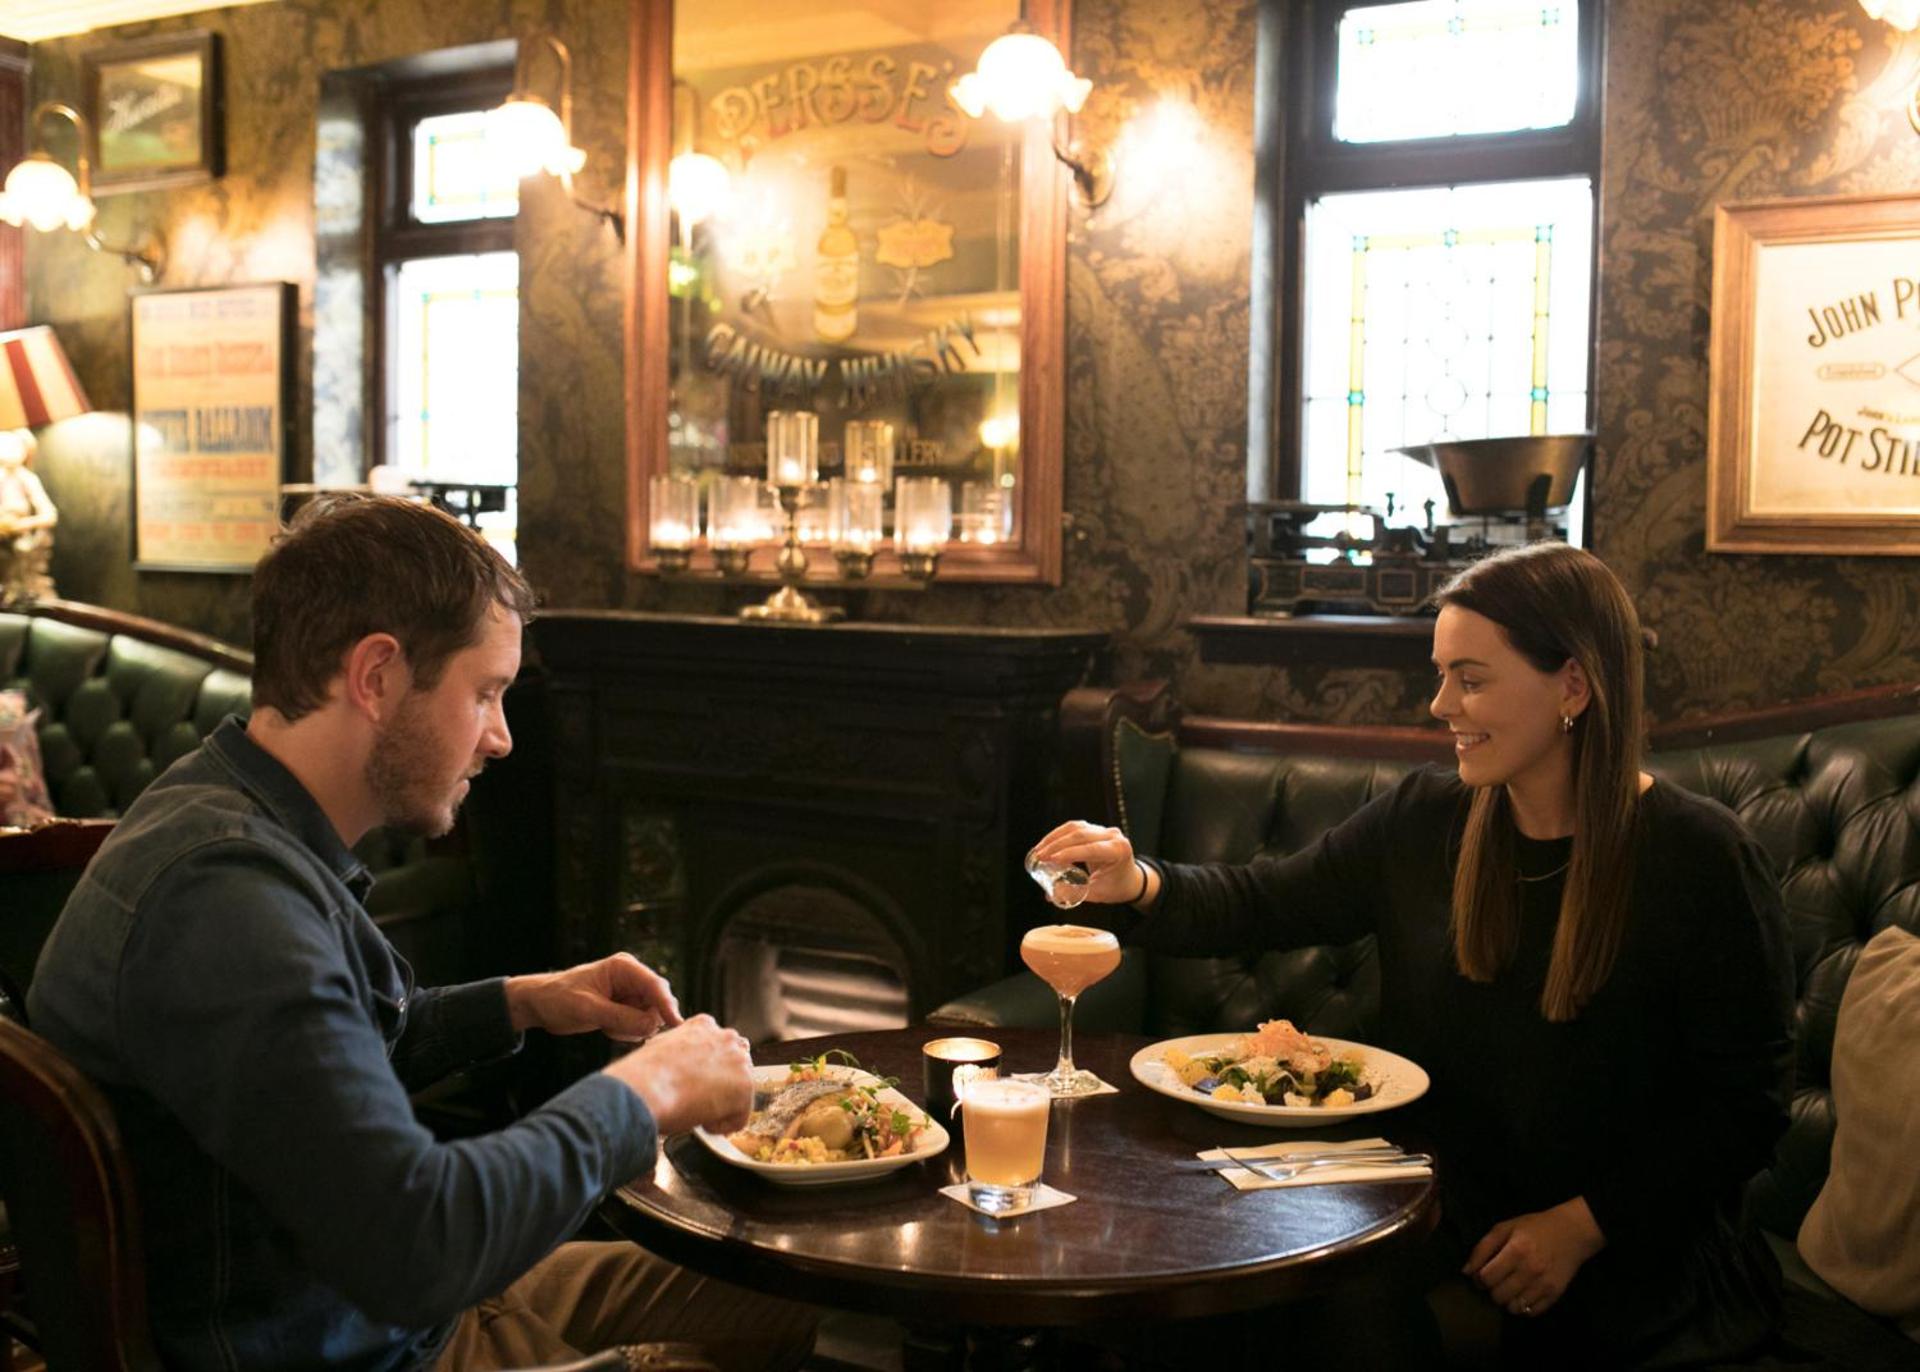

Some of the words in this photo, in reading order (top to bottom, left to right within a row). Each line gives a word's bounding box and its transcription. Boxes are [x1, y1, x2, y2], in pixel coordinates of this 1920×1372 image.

[1808, 291, 1881, 348] JOHN
[1893, 278, 1920, 319] P
[1798, 409, 1863, 464] POT
